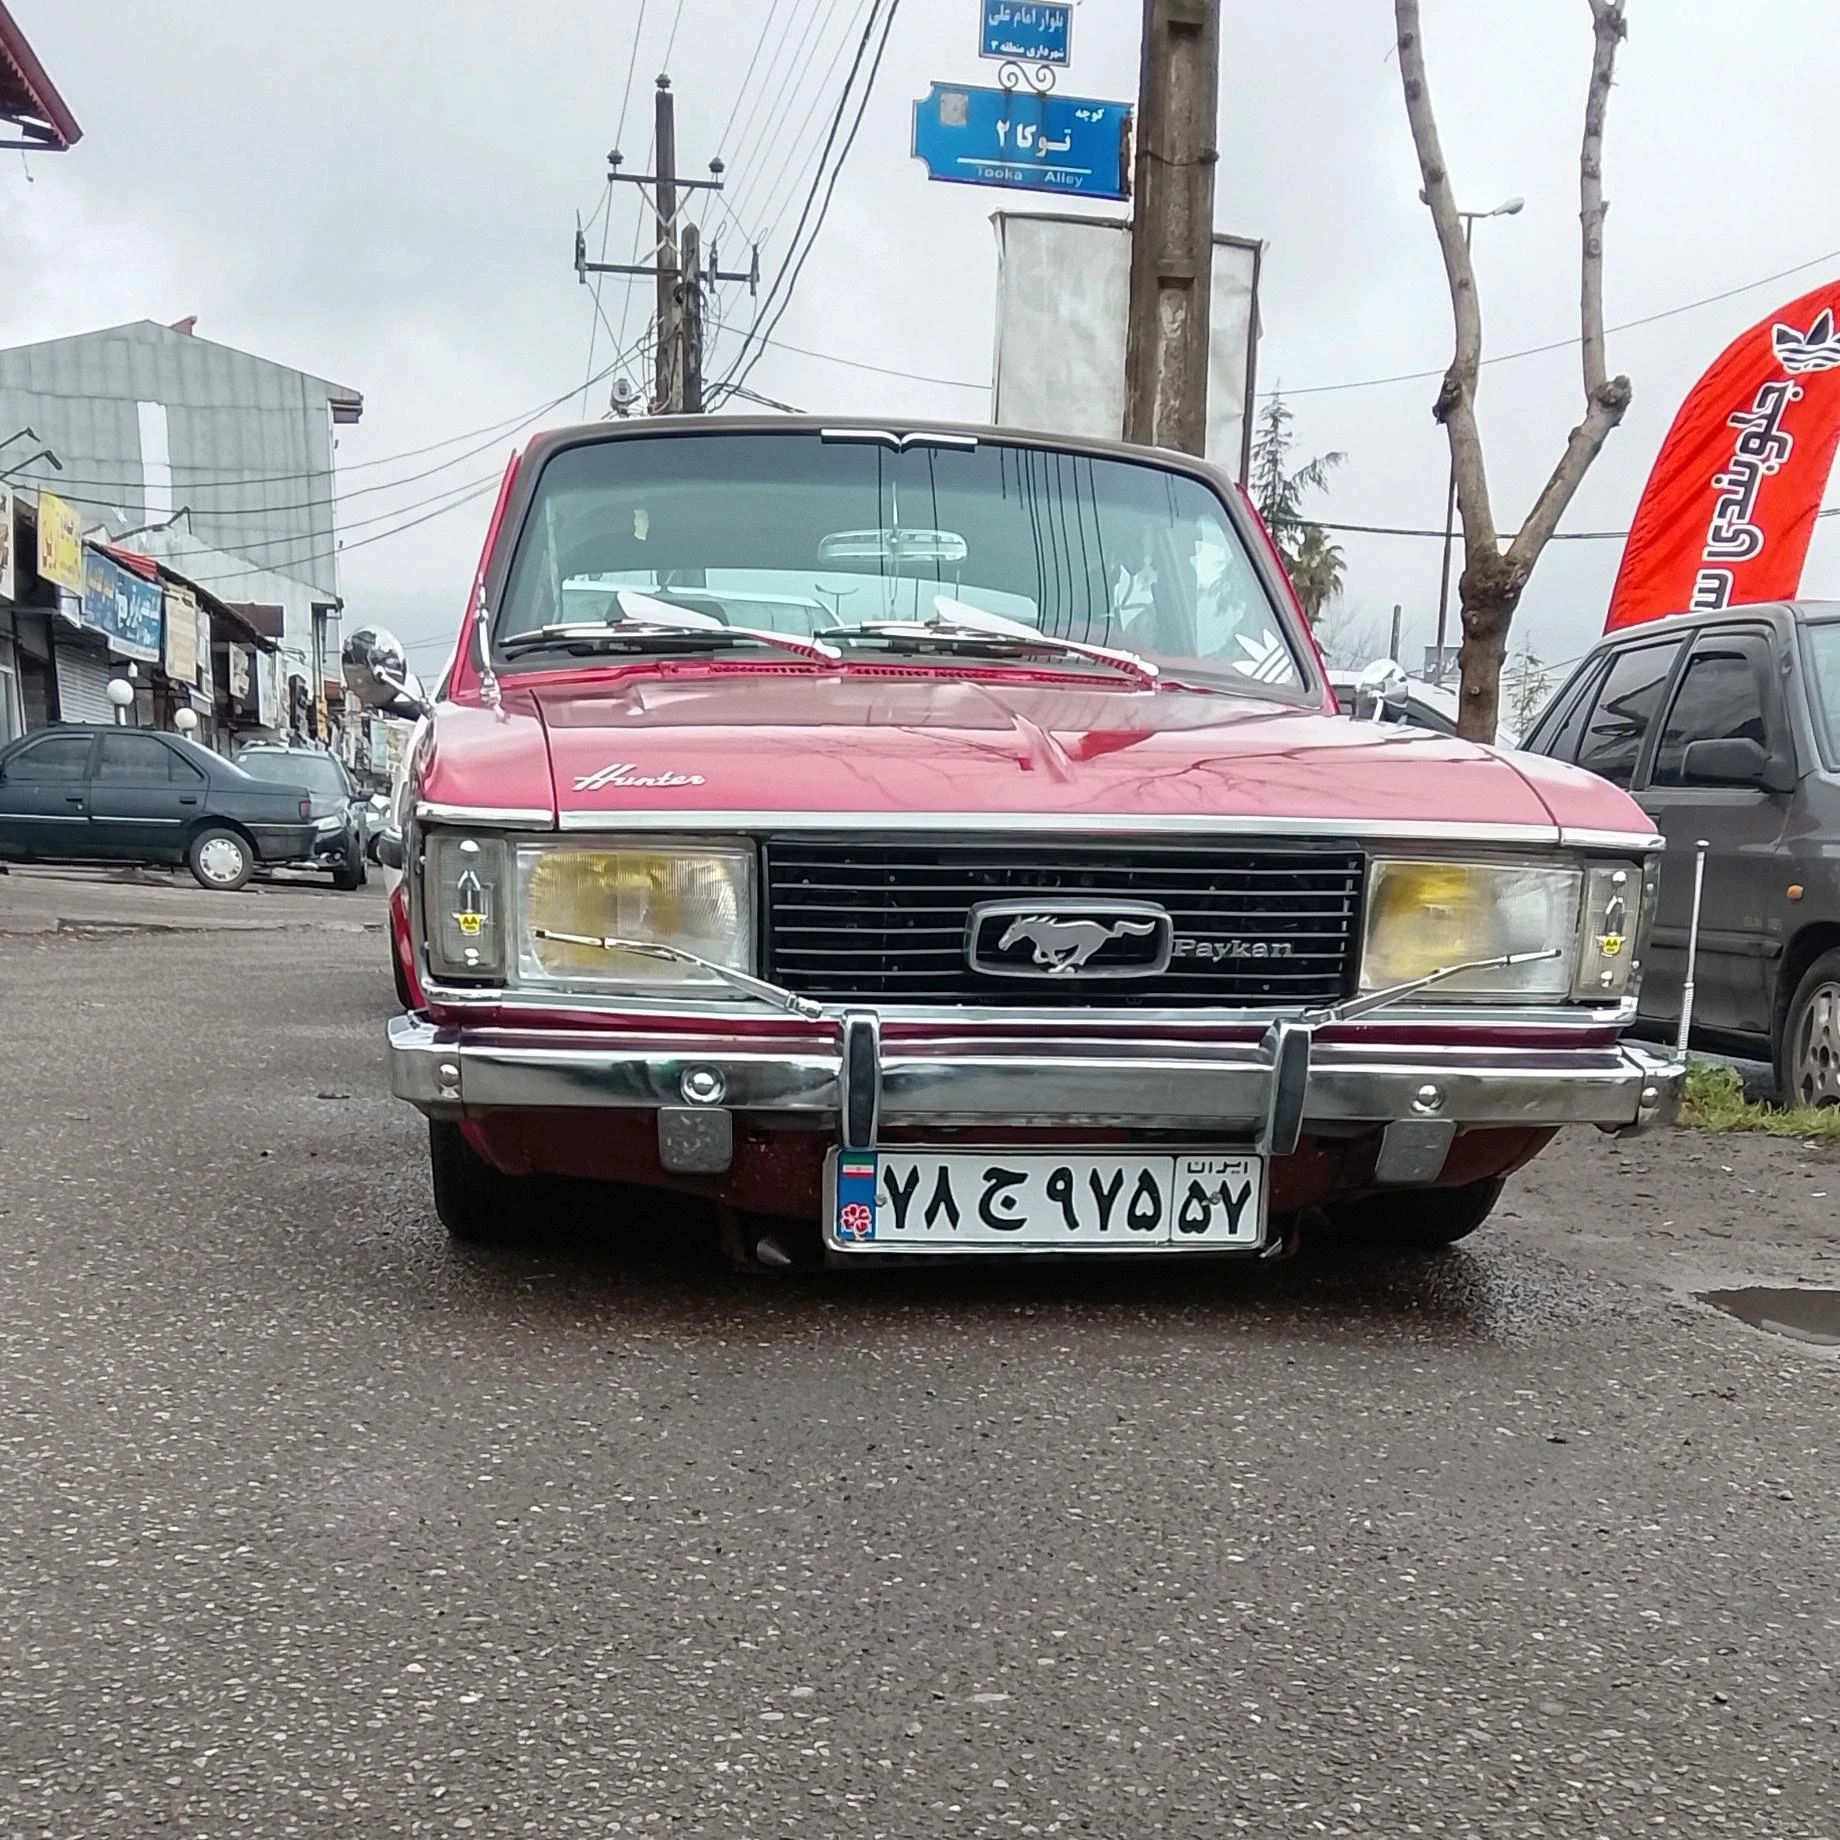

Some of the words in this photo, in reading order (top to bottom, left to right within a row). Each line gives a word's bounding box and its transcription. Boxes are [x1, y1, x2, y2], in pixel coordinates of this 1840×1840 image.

[988, 4, 1011, 26] علی
[1013, 6, 1036, 28] امام
[1037, 8, 1064, 32] بلوار
[1000, 41, 1025, 53] منطقه
[1026, 44, 1064, 59] شهرداری
[1075, 107, 1105, 123] کوچه
[977, 165, 1023, 181] Tooka
[1044, 171, 1084, 188] Alley
[1703, 379, 1804, 563] جلوبندی
[572, 763, 706, 791] Hunter
[1174, 938, 1293, 962] Paykan
[1187, 1161, 1248, 1174] ایران
[1178, 1179, 1252, 1235] ۵۷
